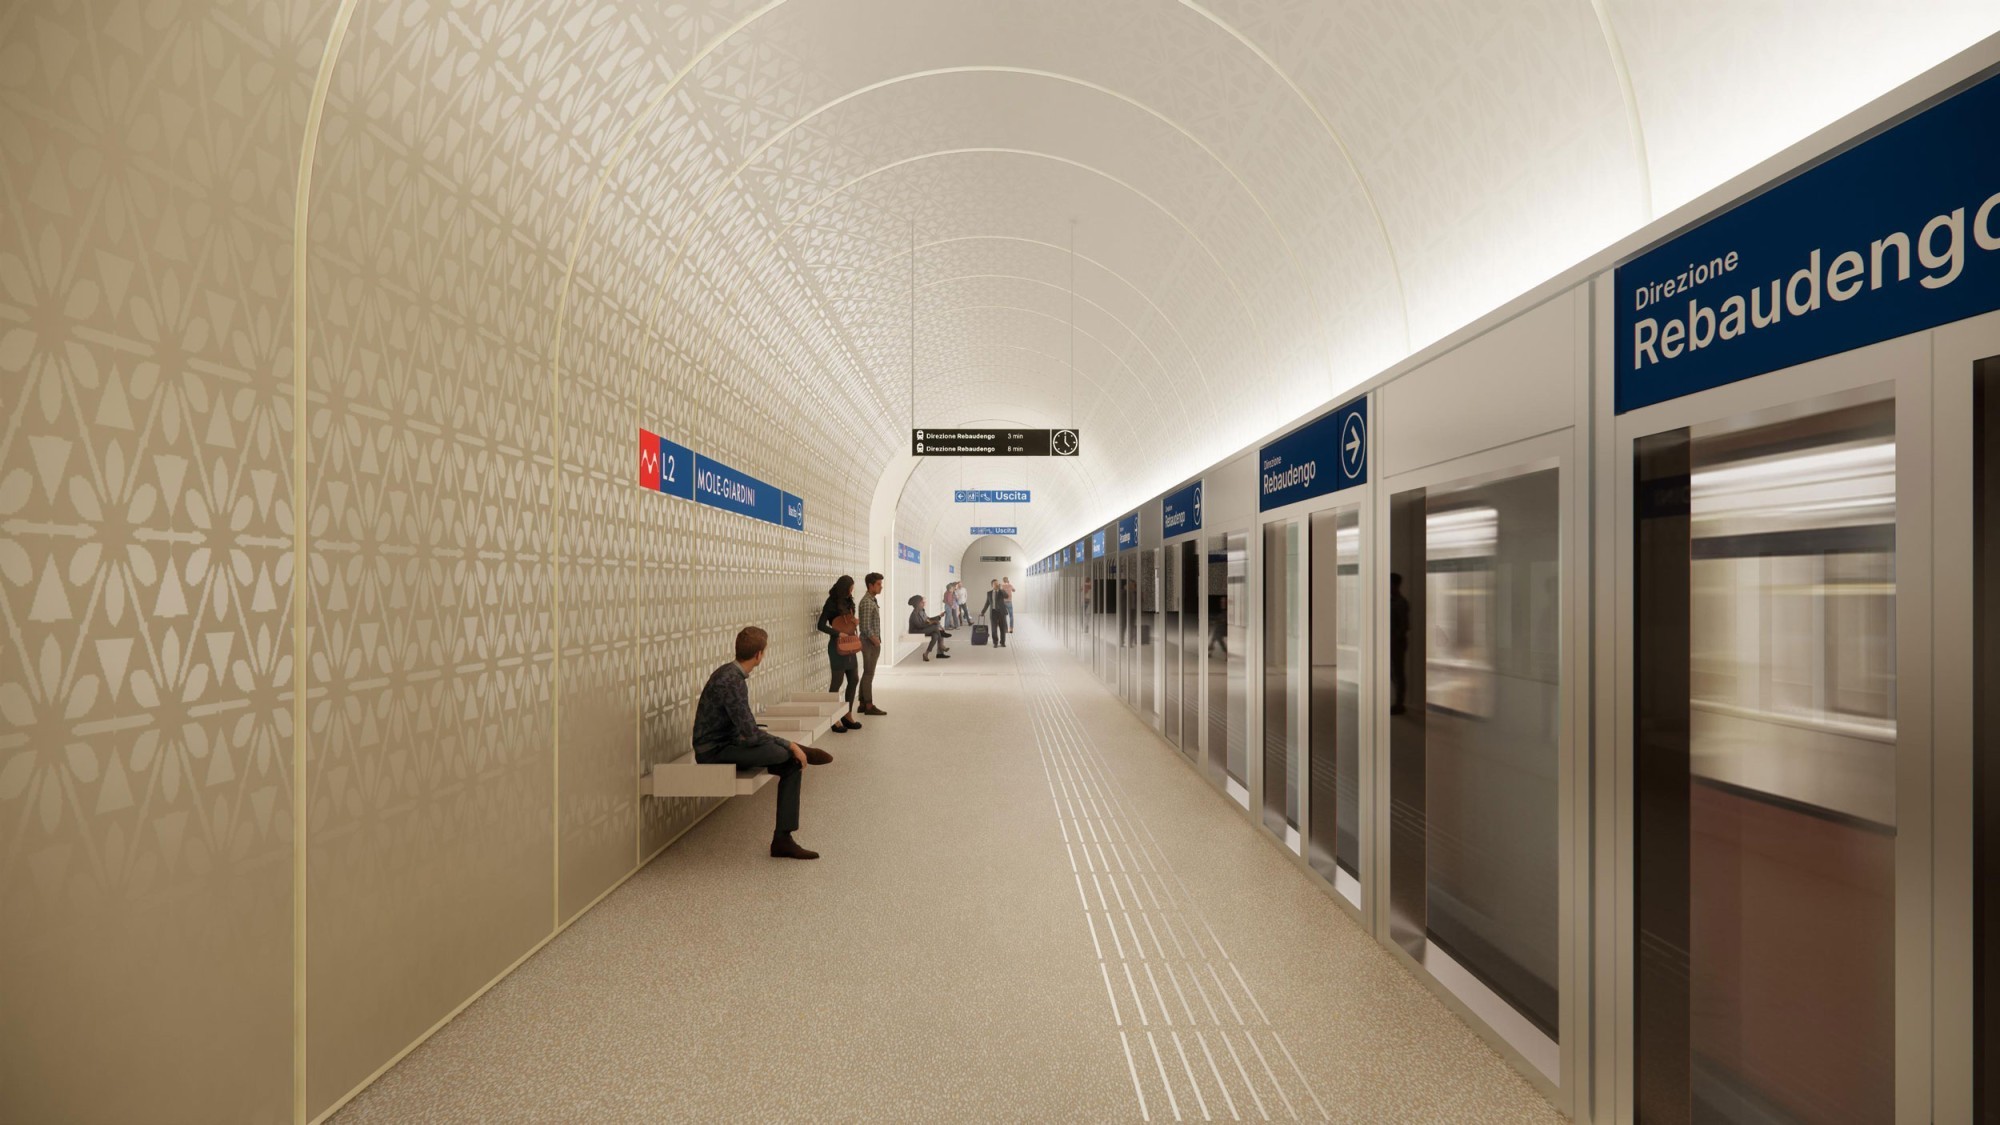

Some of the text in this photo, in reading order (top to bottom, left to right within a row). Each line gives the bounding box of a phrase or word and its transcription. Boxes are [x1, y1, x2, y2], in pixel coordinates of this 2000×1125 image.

[1635, 250, 1739, 311] Direzione
[926, 432, 956, 440] Direzione
[957, 432, 996, 441] Rebaudengo
[926, 445, 956, 453] Direzione
[957, 445, 996, 454] Rebaudengo
[662, 452, 676, 483] L2
[1263, 460, 1317, 496] Rebaudengo
[697, 468, 756, 507] MOLE-GIARDINI
[995, 491, 1028, 501] Uscita
